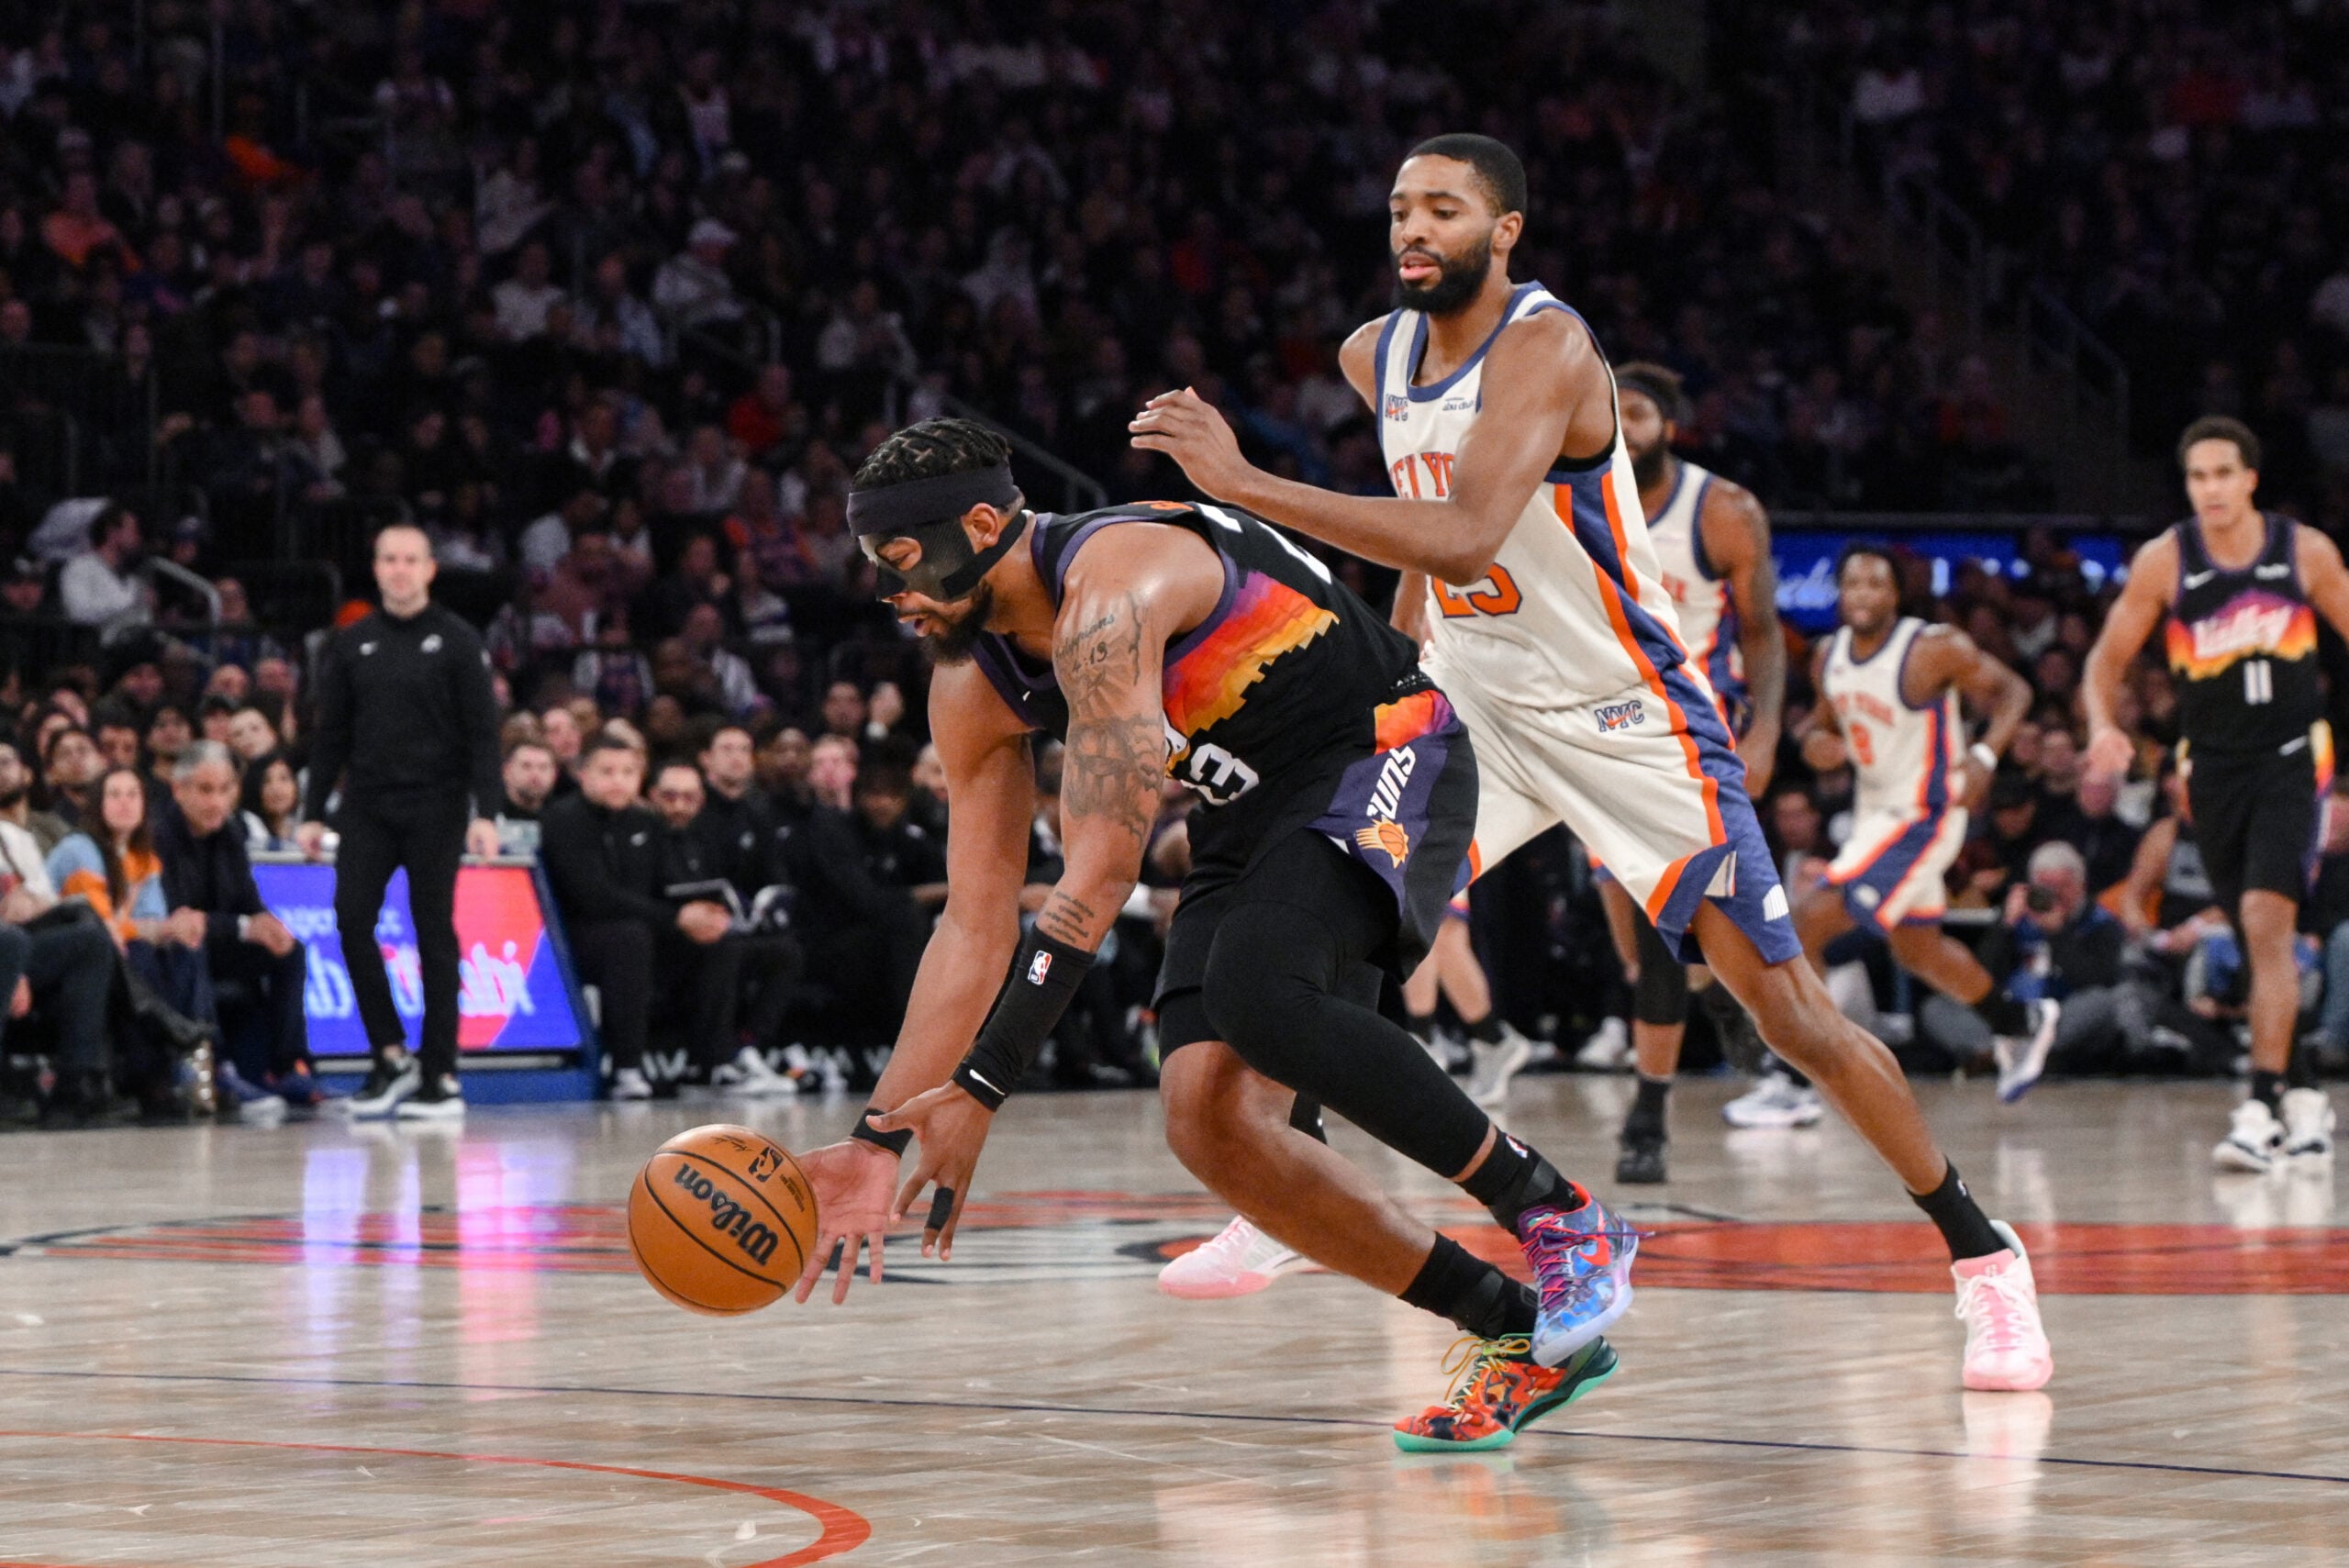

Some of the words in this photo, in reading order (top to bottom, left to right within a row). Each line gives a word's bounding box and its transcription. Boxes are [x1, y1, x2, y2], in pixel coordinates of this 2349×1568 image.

[2243, 660, 2273, 705] 11
[1594, 699, 1644, 733] NYC
[674, 1162, 780, 1267] Wilson
